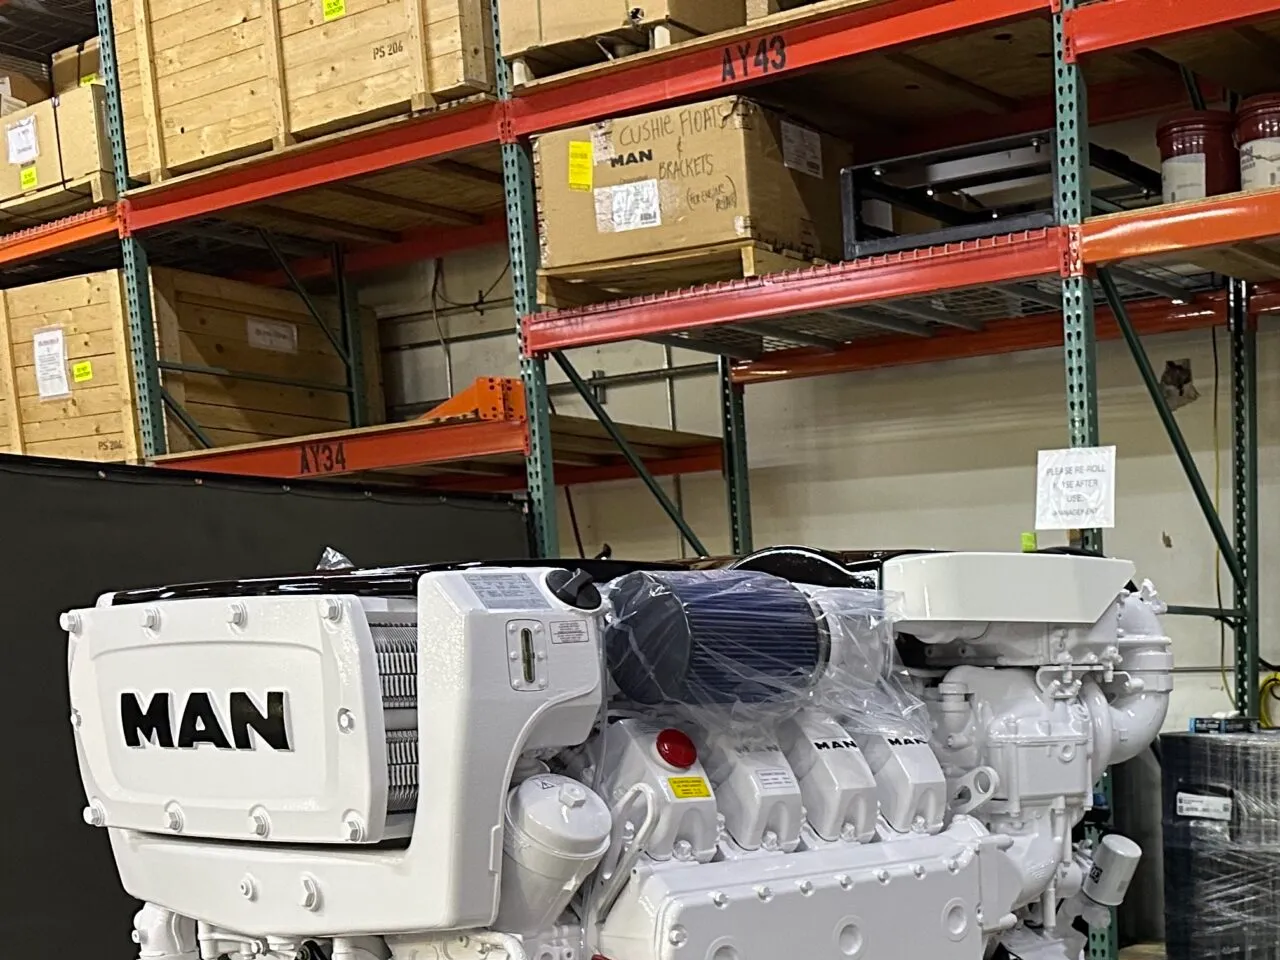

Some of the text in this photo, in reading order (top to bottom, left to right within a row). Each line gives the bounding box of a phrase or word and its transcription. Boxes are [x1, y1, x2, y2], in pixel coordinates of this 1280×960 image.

[373, 40, 404, 60] PS 206
[722, 35, 786, 82] AY43
[610, 148, 653, 168] MAN
[658, 153, 714, 181] BRACKETS
[300, 441, 347, 475] AY34
[1046, 464, 1106, 477] PLEASE RE-ROLL
[1075, 479, 1098, 488] AFTER
[120, 691, 291, 751] MAN
[814, 740, 858, 750] MAN
